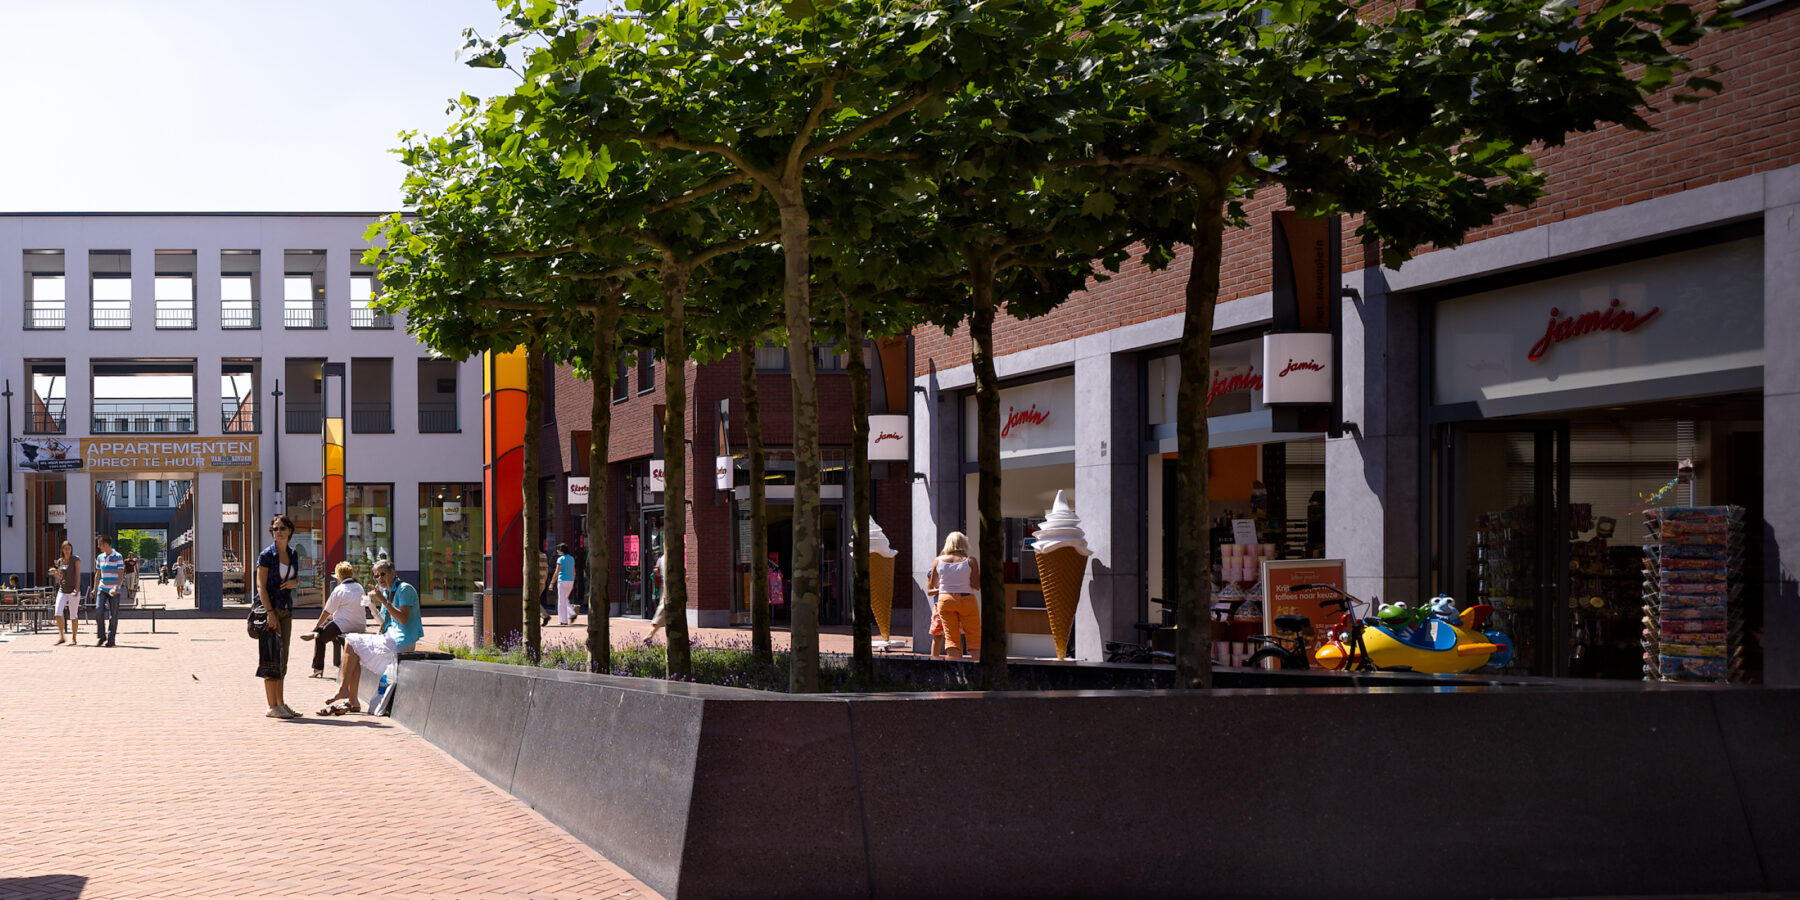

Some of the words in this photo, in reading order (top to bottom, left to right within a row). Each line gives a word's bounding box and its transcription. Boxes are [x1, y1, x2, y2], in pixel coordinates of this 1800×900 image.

[1528, 298, 1660, 362] jamin
[1278, 359, 1325, 377] jamin
[1206, 365, 1263, 409] jamin
[1001, 404, 1050, 439] jamin
[874, 431, 903, 444] jamin
[87, 441, 252, 455] APPARTEMENTEN
[86, 457, 138, 467] DIRECT
[143, 457, 160, 467] TE
[165, 457, 205, 467] HUUR
[1275, 592, 1298, 601] toffees
[1317, 591, 1338, 599] keuze
